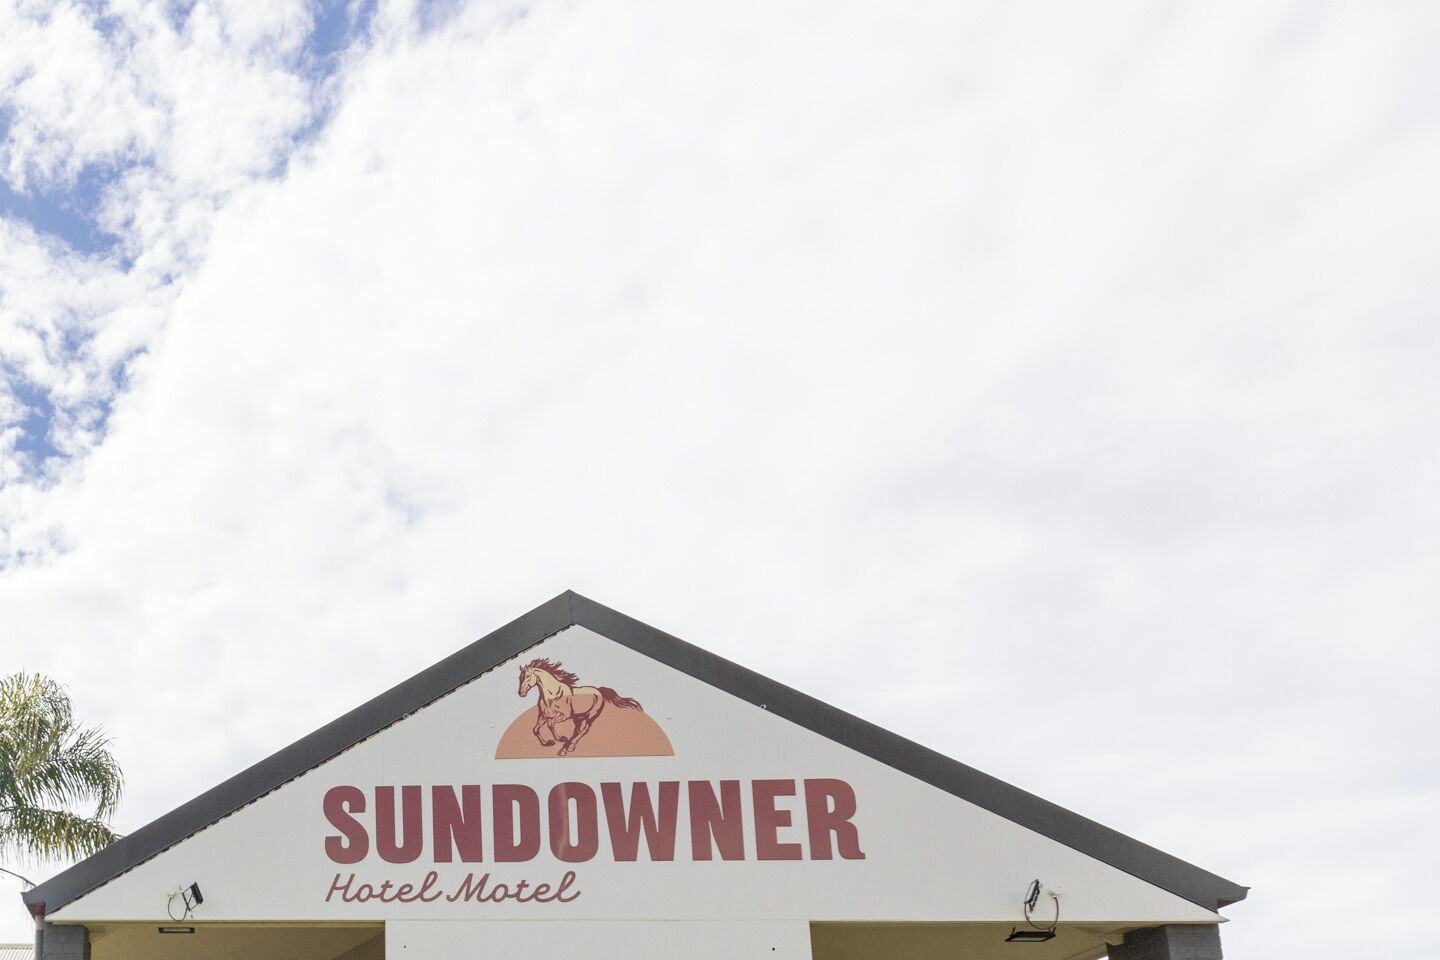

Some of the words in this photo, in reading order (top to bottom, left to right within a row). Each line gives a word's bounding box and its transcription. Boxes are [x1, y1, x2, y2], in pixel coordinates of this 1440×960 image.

[323, 778, 866, 864] SUNDOWNER
[325, 871, 442, 903] Hotel
[446, 871, 581, 903] Motel
